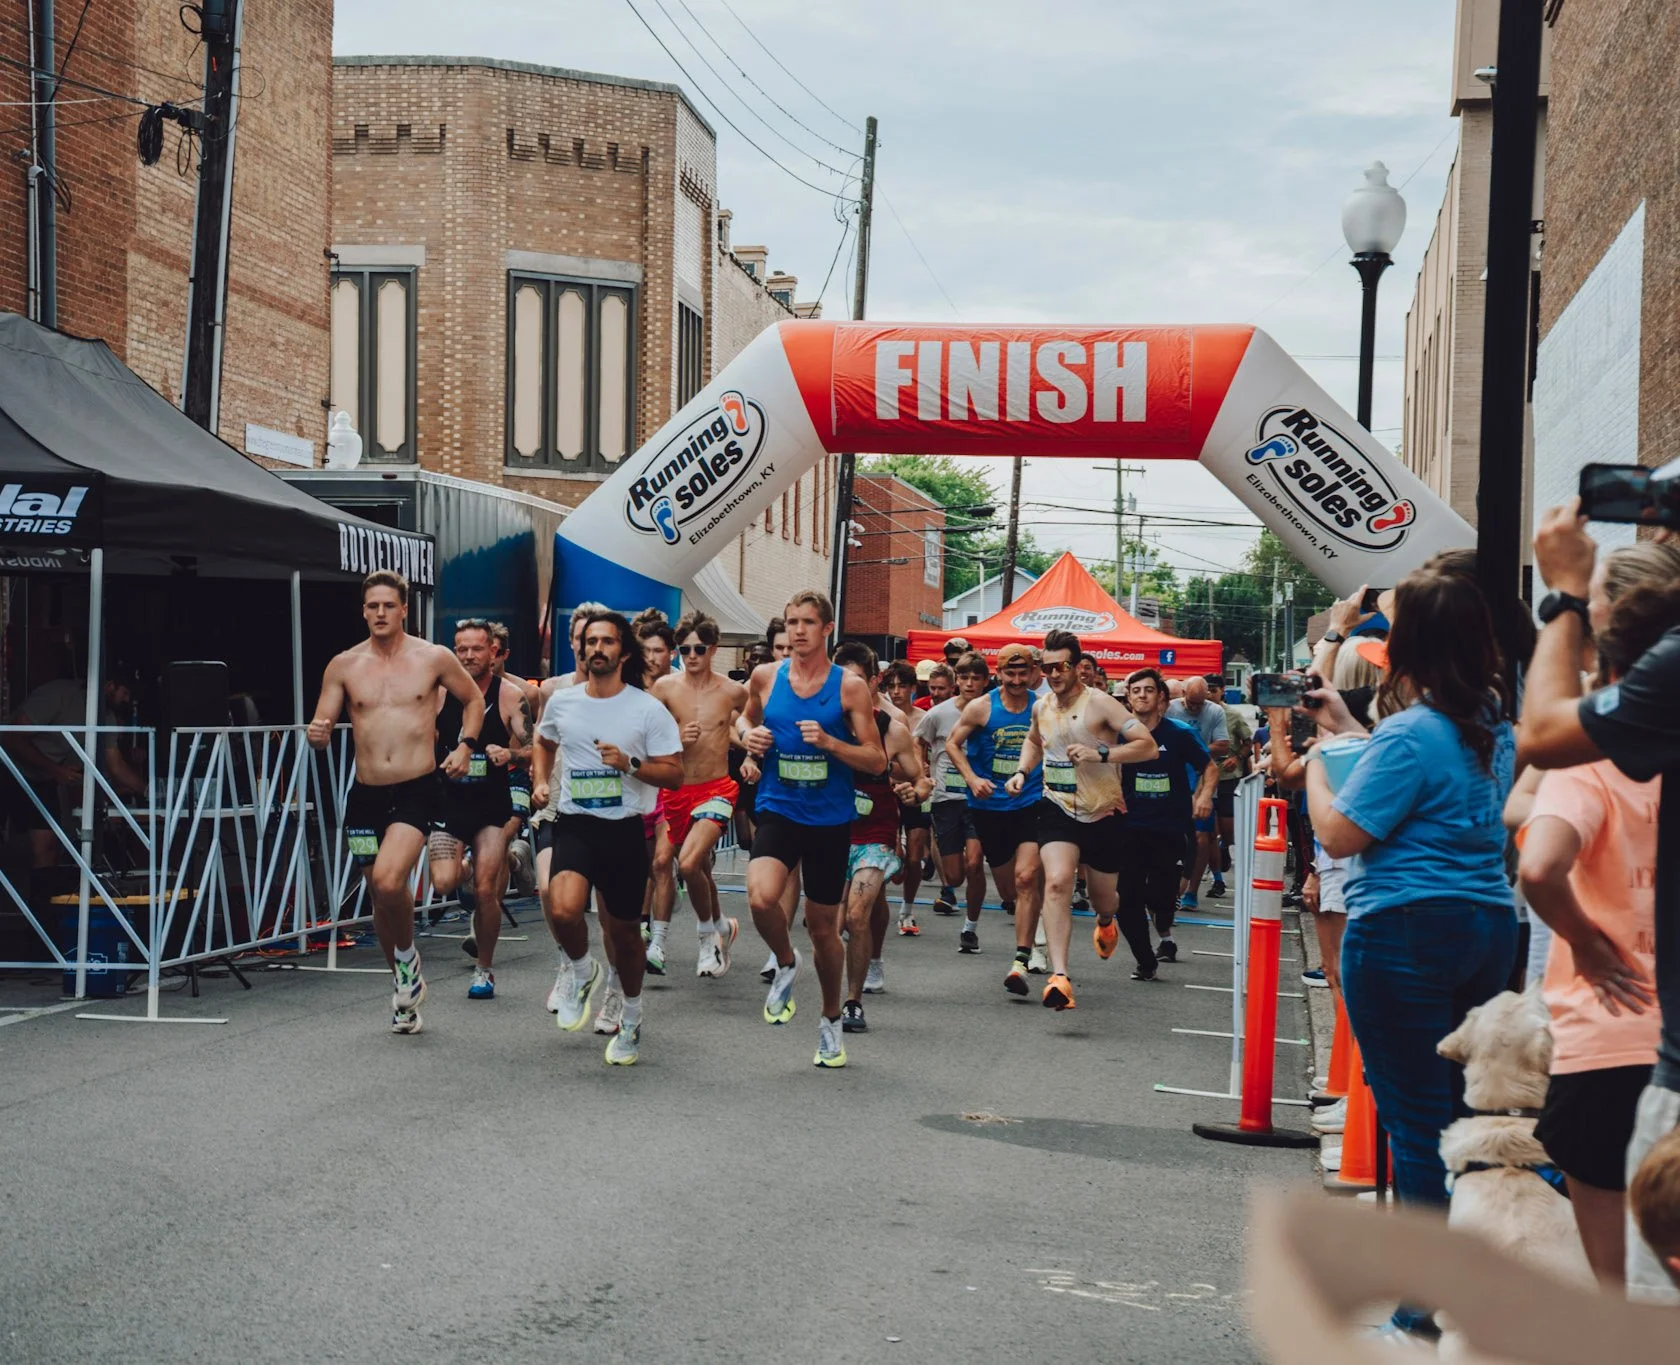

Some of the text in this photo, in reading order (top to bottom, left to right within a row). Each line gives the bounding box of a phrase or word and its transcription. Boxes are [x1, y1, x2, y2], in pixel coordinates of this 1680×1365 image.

[875, 340, 1147, 423] FINISH
[629, 416, 729, 511] Running
[675, 440, 743, 510] soles
[1281, 408, 1389, 513] Running
[1284, 459, 1361, 528] soles
[0, 518, 73, 534] TRIES
[689, 462, 776, 545] Elizabethtown, KY
[1246, 473, 1339, 560] Elizabethtown, KY
[338, 522, 434, 586] ROCKETPOWER
[1020, 611, 1097, 623] Running
[1042, 621, 1094, 631] soles
[576, 780, 617, 797] 1024
[781, 761, 825, 780] 1035
